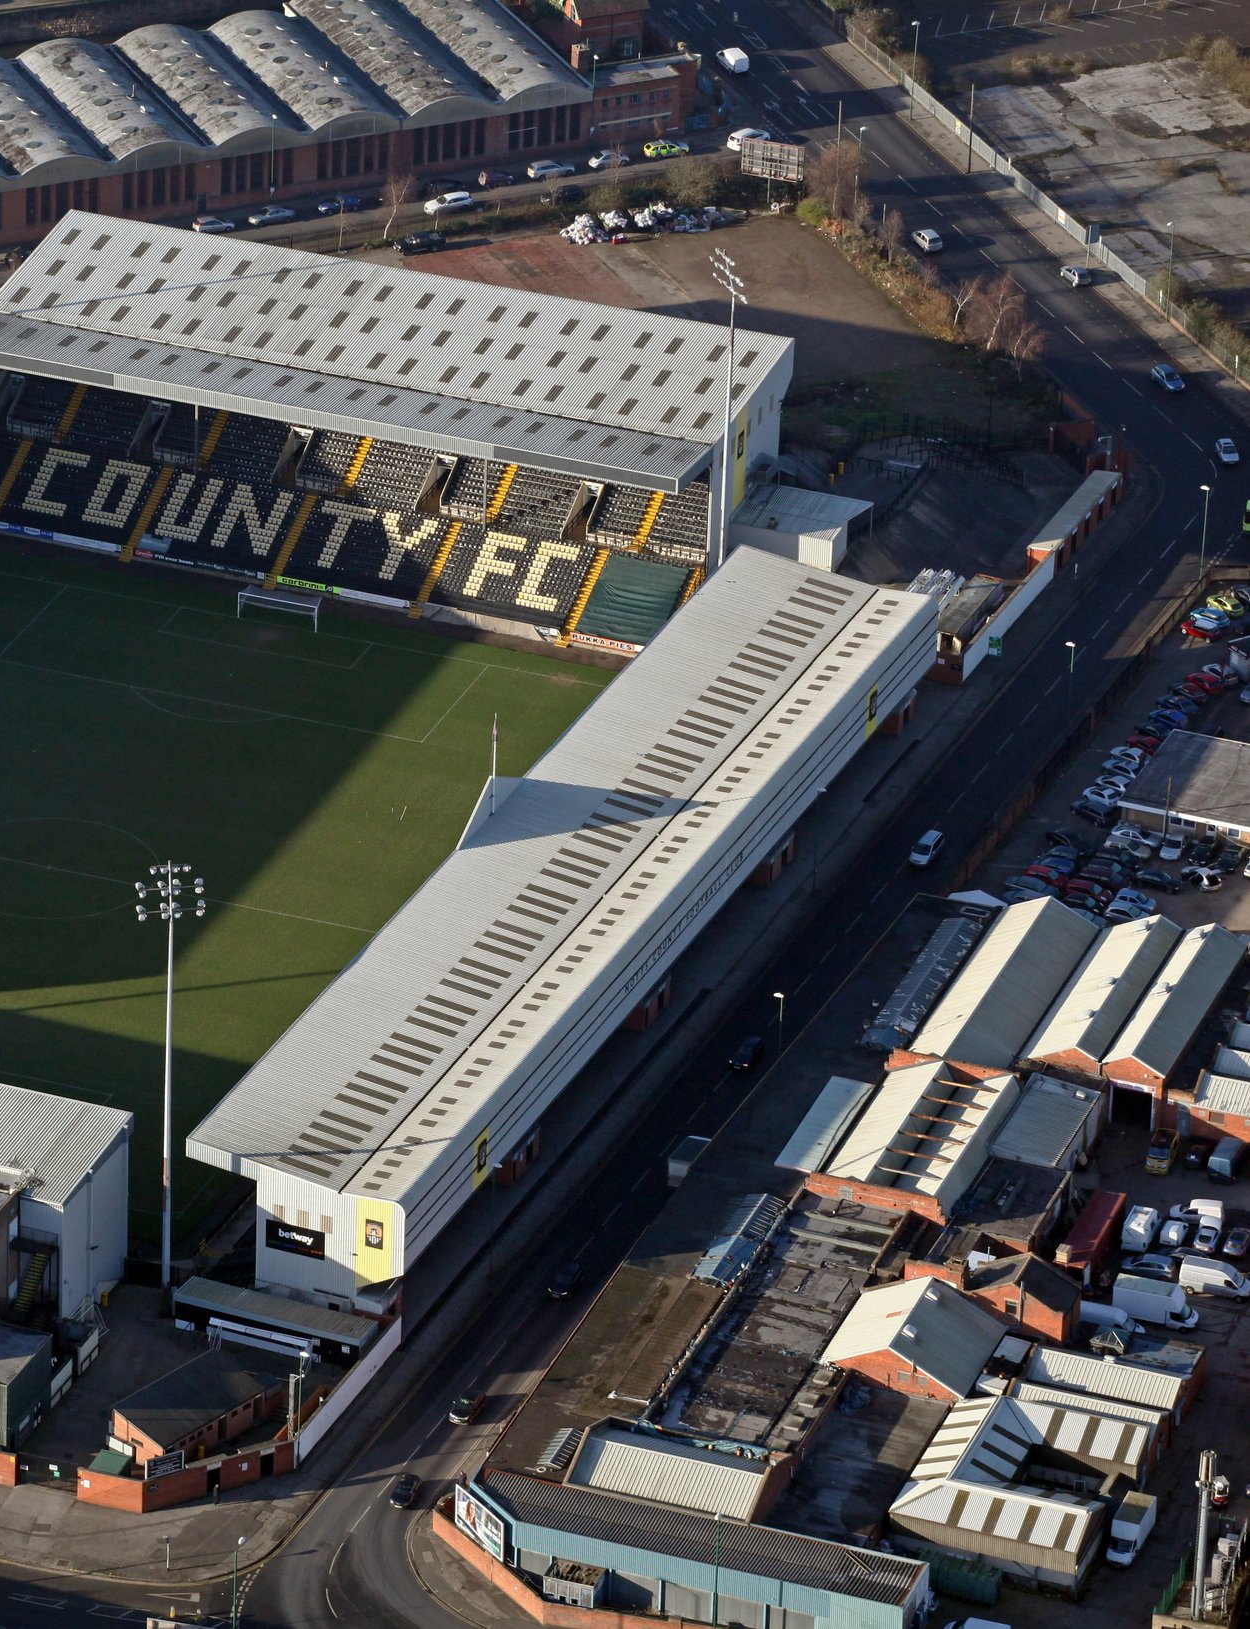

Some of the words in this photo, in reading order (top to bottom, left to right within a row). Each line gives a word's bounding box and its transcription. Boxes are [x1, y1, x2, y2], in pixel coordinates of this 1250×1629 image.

[22, 447, 439, 580] COUNTY
[463, 531, 580, 611] FC
[624, 961, 649, 994] NOTTS
[652, 921, 683, 961] COUNTY
[685, 879, 722, 923] FOOTBALL
[725, 851, 744, 877] CLUB
[278, 1228, 314, 1246] betway
